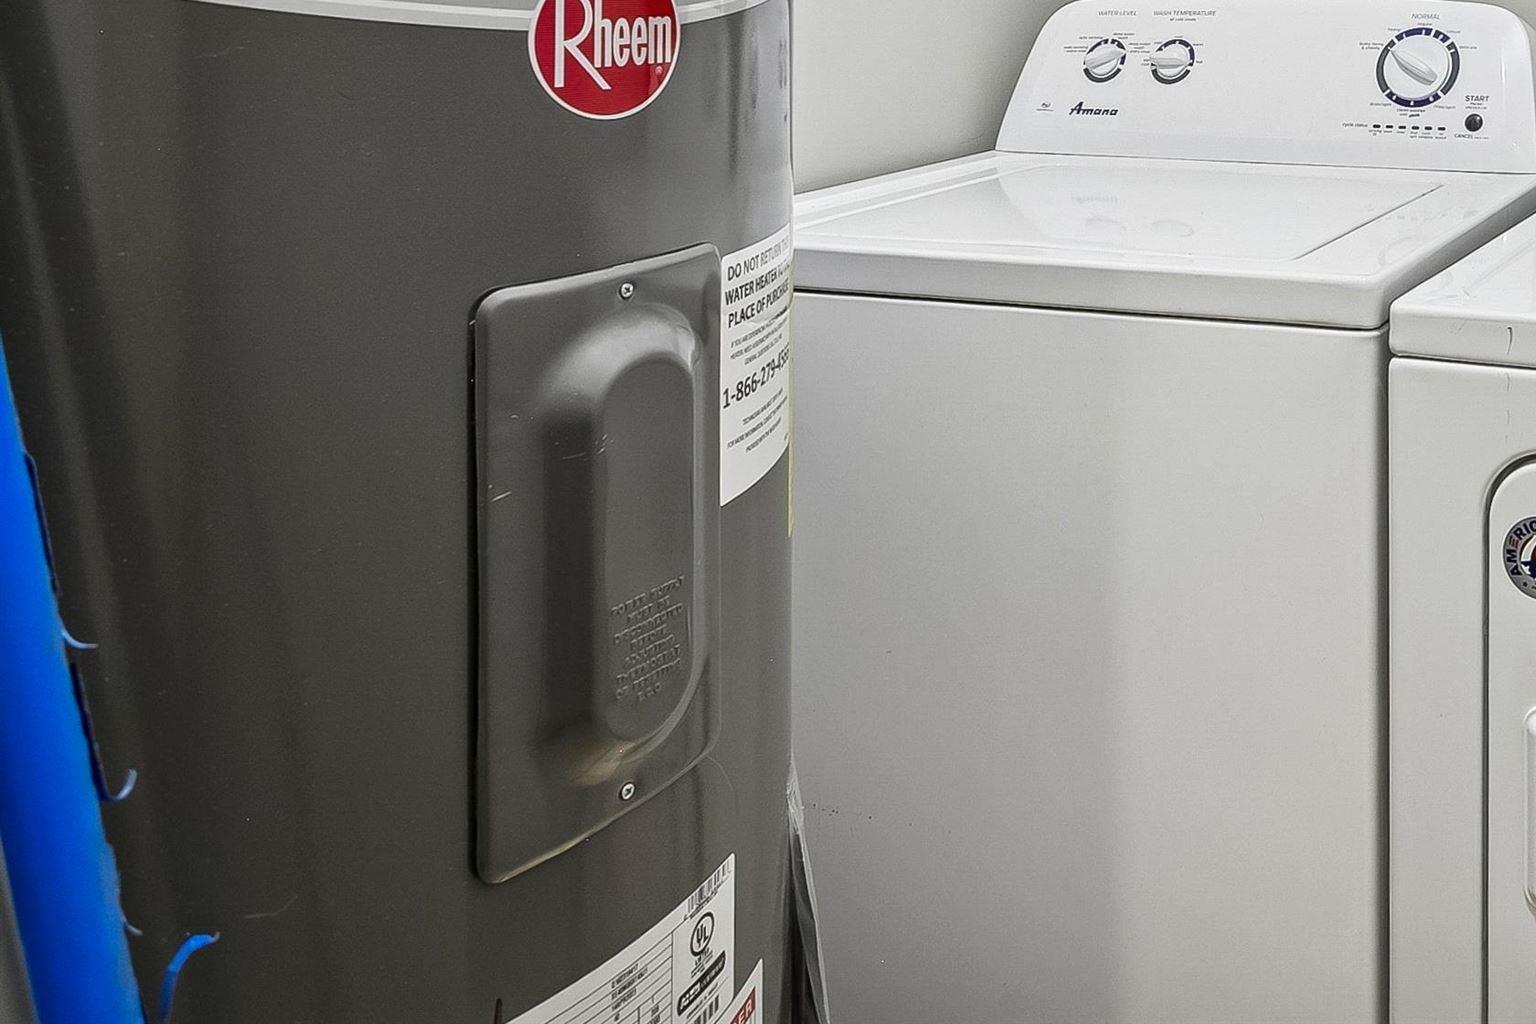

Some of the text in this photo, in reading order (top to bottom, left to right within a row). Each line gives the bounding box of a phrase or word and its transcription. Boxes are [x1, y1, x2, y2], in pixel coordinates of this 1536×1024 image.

[1069, 101, 1119, 116] Amana
[727, 263, 742, 281] DO
[743, 254, 759, 275] NOT
[725, 280, 754, 306] WATER
[755, 267, 777, 292] HEATER
[728, 302, 756, 328] PLACE
[756, 296, 766, 314] OF
